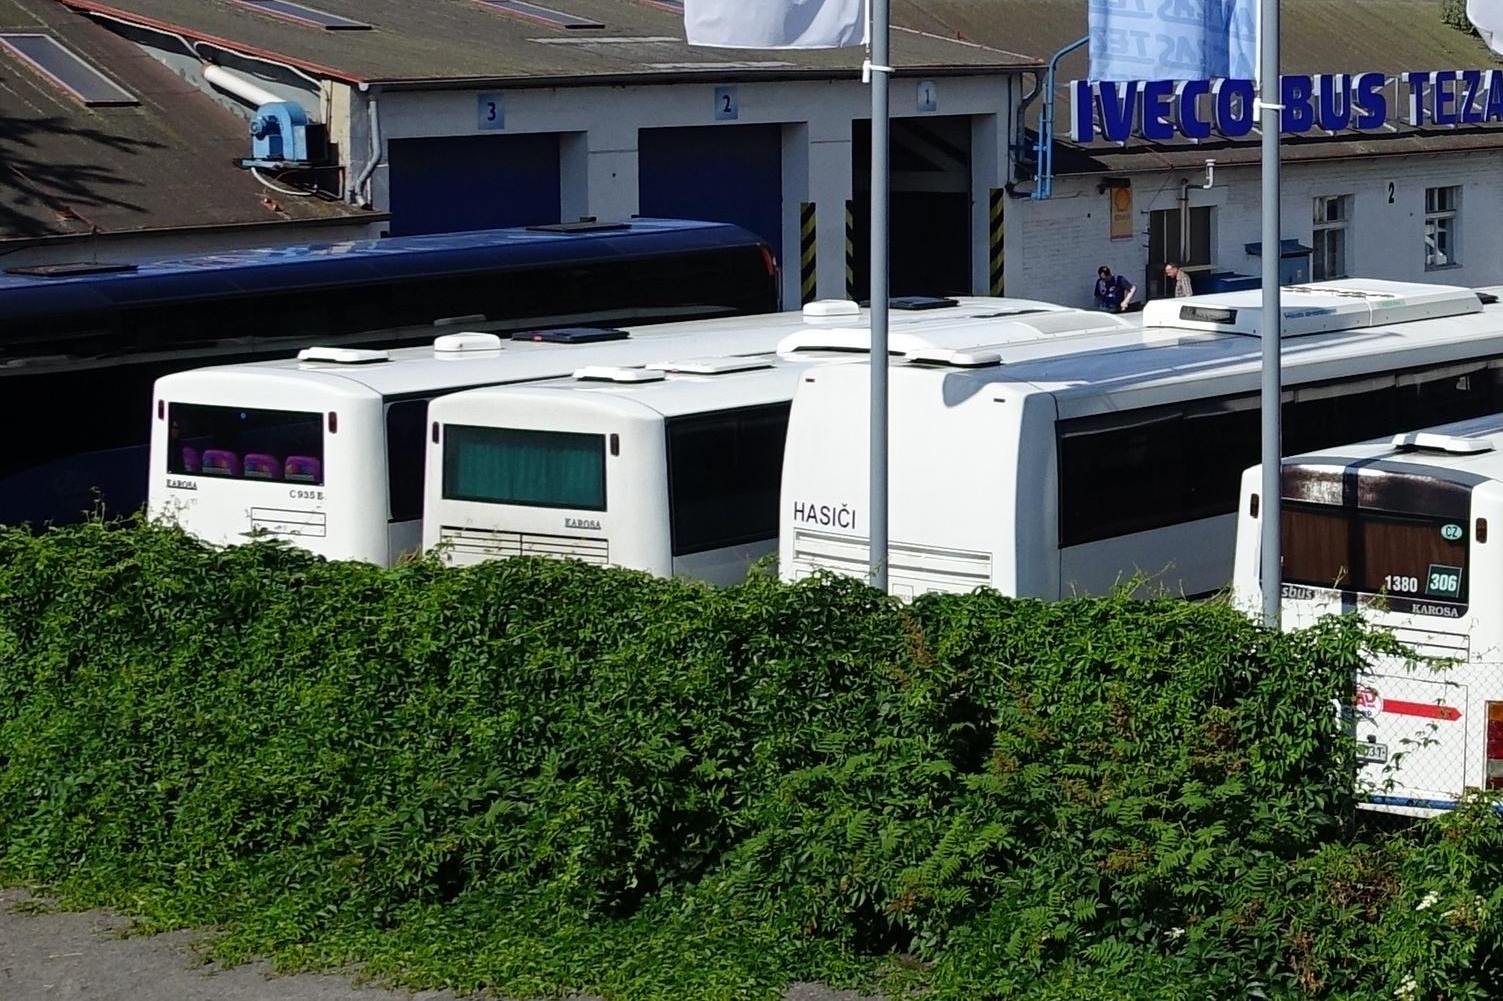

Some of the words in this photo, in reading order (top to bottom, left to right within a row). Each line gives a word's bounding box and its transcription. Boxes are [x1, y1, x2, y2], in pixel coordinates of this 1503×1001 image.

[723, 95, 732, 113] 2
[924, 89, 930, 105] 1
[487, 101, 497, 122] 3
[1072, 79, 1255, 142] IVECO
[1281, 72, 1387, 133] BUS
[1388, 181, 1395, 204] 2
[794, 501, 856, 530] HASIČI
[1446, 526, 1458, 538] CZ
[1281, 584, 1313, 599] sbus
[1385, 575, 1418, 592] 1380
[1430, 574, 1458, 592] 306
[1412, 604, 1459, 618] KAROSA
